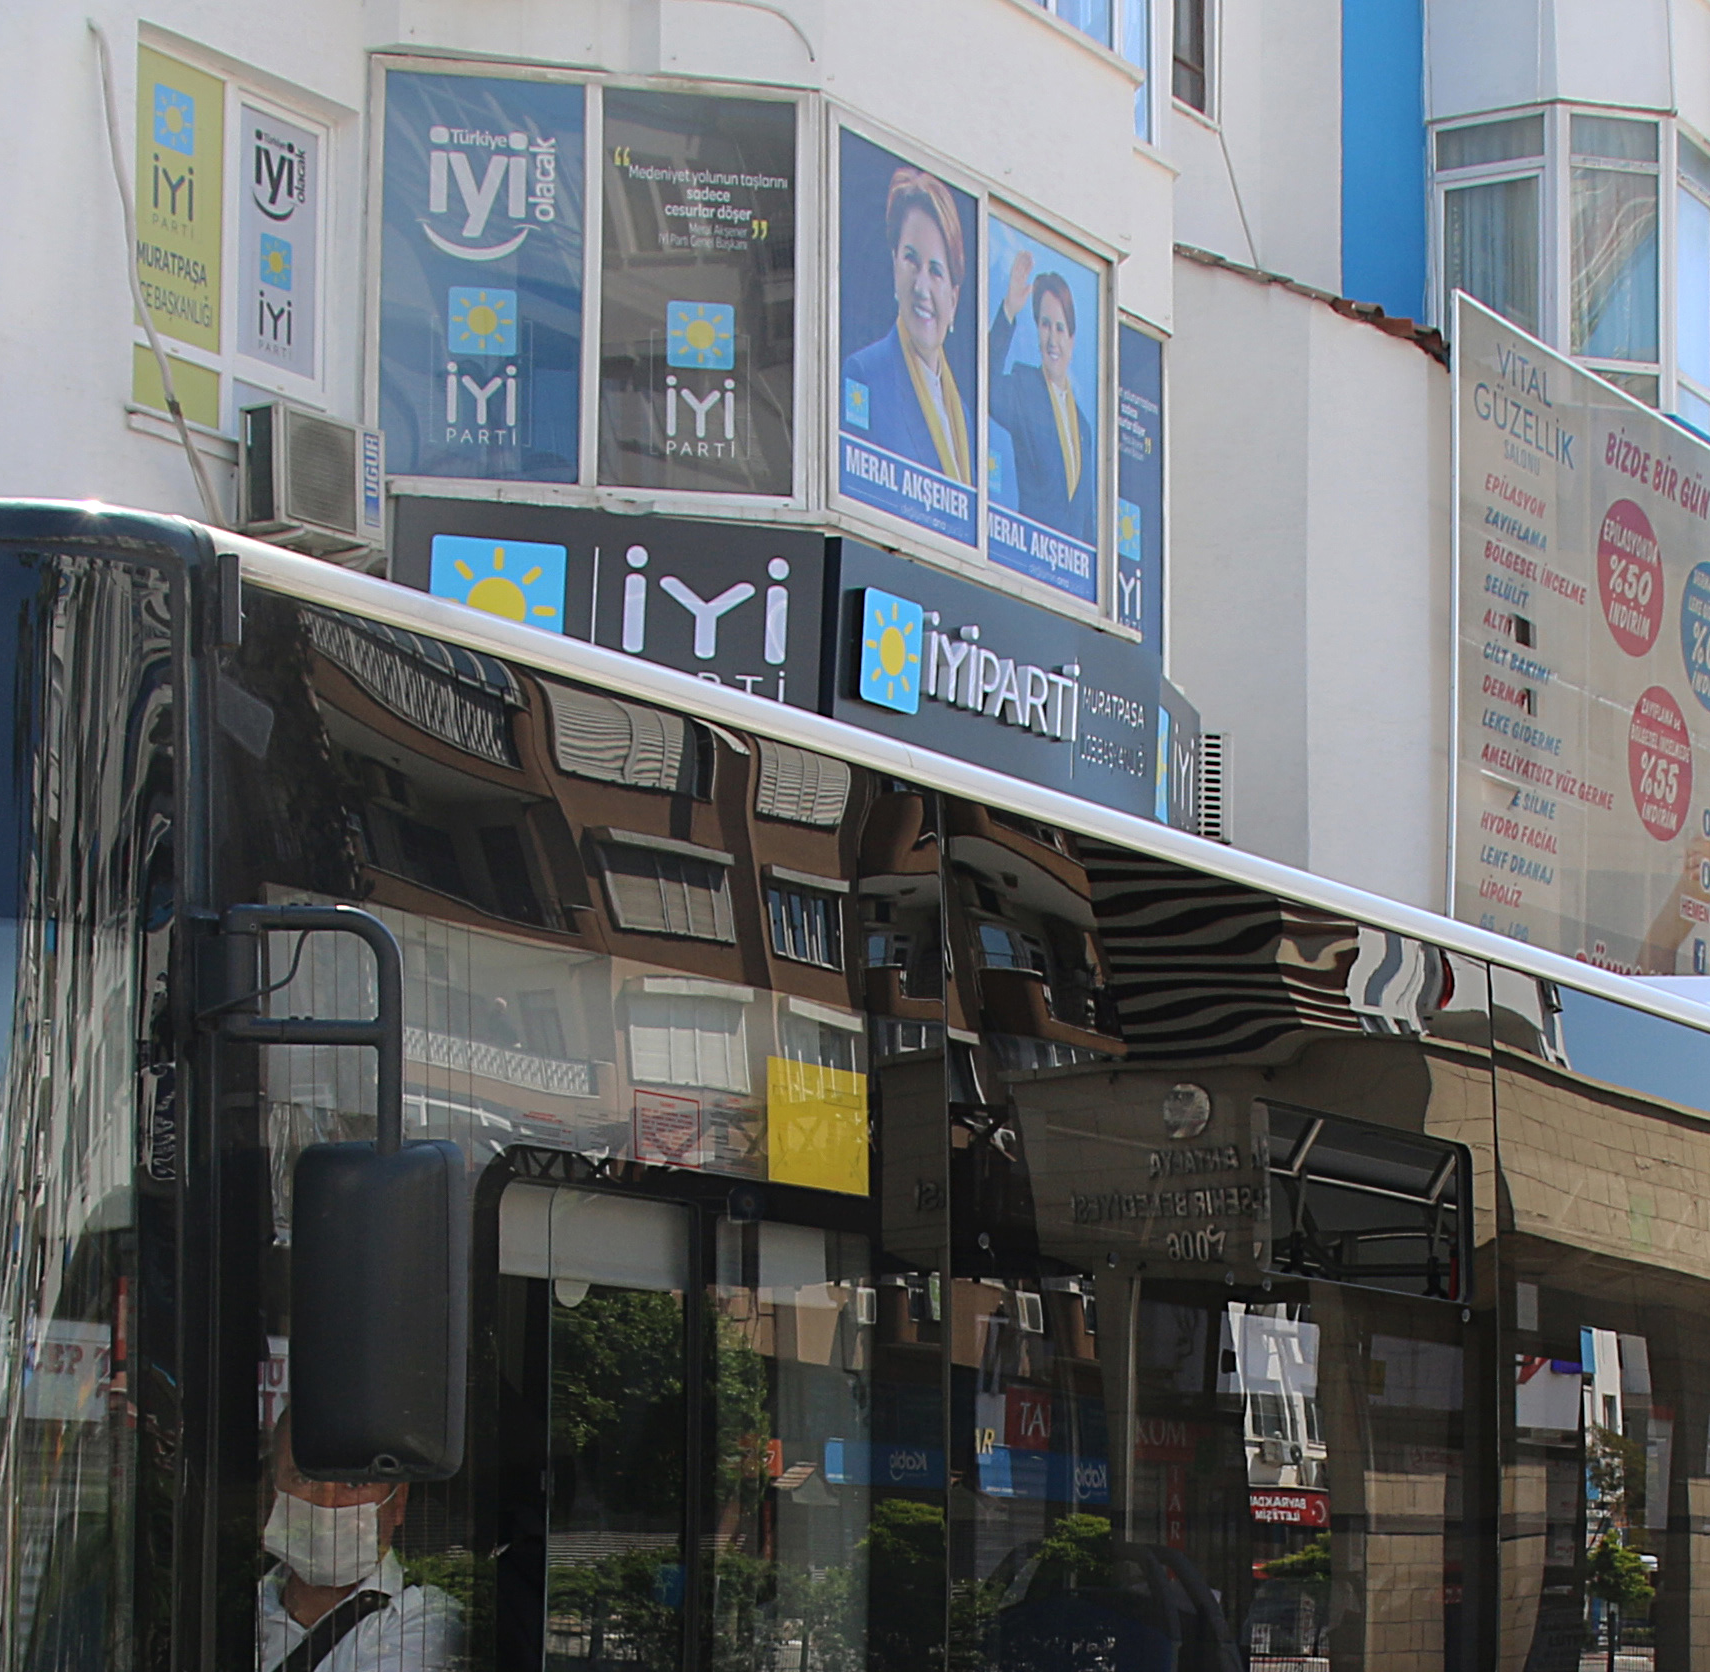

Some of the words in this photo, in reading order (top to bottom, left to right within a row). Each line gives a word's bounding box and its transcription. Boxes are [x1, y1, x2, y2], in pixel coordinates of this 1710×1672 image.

[450, 128, 507, 150] Türkiye
[295, 149, 306, 204] olacak
[528, 137, 557, 223] olacak
[628, 165, 691, 185] Medeniyet
[691, 170, 739, 188] yolunun
[686, 187, 731, 203] sadece
[665, 203, 716, 219] cesurlar
[717, 204, 752, 222] döşer
[1497, 342, 1552, 408] VİTAL
[446, 427, 517, 446] PARTİ
[1474, 382, 1574, 470] GÜZELLİK
[1504, 439, 1540, 476] SALONU
[1605, 427, 1650, 485] BİZDE
[1652, 456, 1677, 501] BİR
[1680, 473, 1710, 520] GÜN
[845, 444, 898, 492] MERAL
[902, 469, 969, 522] AKŞENER
[1485, 474, 1546, 519] EPİLASYON
[1485, 506, 1547, 551] ZAYIFLAMA
[1030, 531, 1090, 580] AKŞENER
[1484, 539, 1538, 583] BÖLGESEL
[1540, 564, 1587, 605] İNCELME
[1119, 568, 1141, 620] Yİ
[1484, 574, 1529, 609] SELÜLİT
[1609, 554, 1653, 606] %50
[1608, 593, 1650, 641] İNDİRİM
[1484, 640, 1508, 666] CİLT
[1482, 709, 1509, 735] LEKE
[1511, 719, 1561, 757] GİDERME
[1481, 743, 1554, 786] AMELİYATSIZ
[1555, 770, 1576, 794] YÜZ
[1578, 780, 1613, 811] GERME
[1639, 751, 1679, 804] %55
[1524, 789, 1555, 821] SİLME
[1641, 798, 1678, 831] İNDİRİM
[1480, 811, 1520, 842] HYDRO
[1520, 826, 1558, 855] FACİAL
[1480, 844, 1509, 866] LENF
[1510, 853, 1554, 886] DRANAJ
[1479, 873, 1523, 909] LİPOLİZ
[1680, 897, 1710, 925] HEMEN
